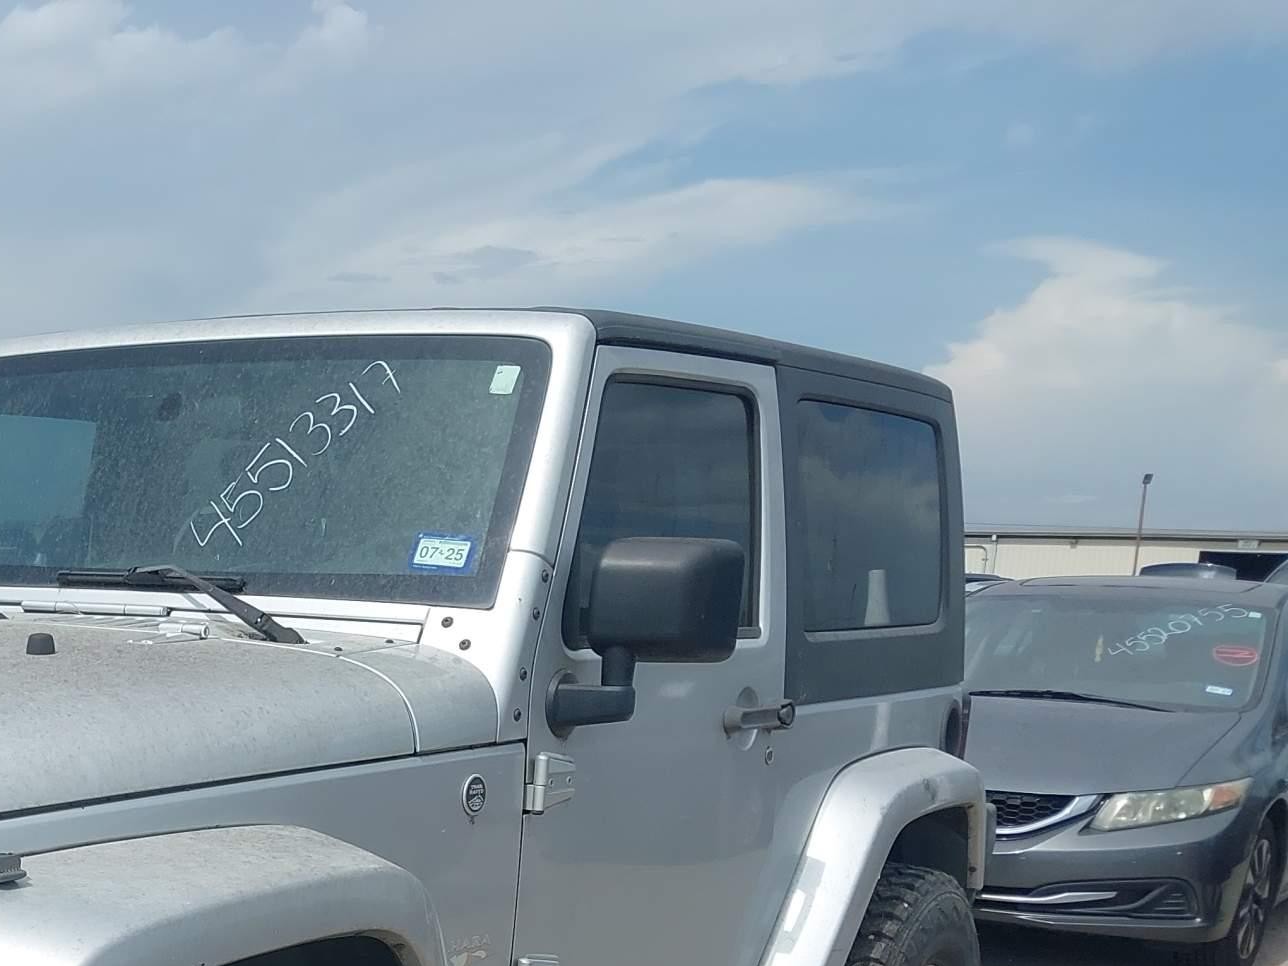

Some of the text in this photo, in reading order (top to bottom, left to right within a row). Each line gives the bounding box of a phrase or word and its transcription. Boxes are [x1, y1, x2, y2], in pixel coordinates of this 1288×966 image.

[190, 360, 401, 546] 45513317
[419, 545, 465, 561] 07 25
[1107, 603, 1249, 655] 45520755
